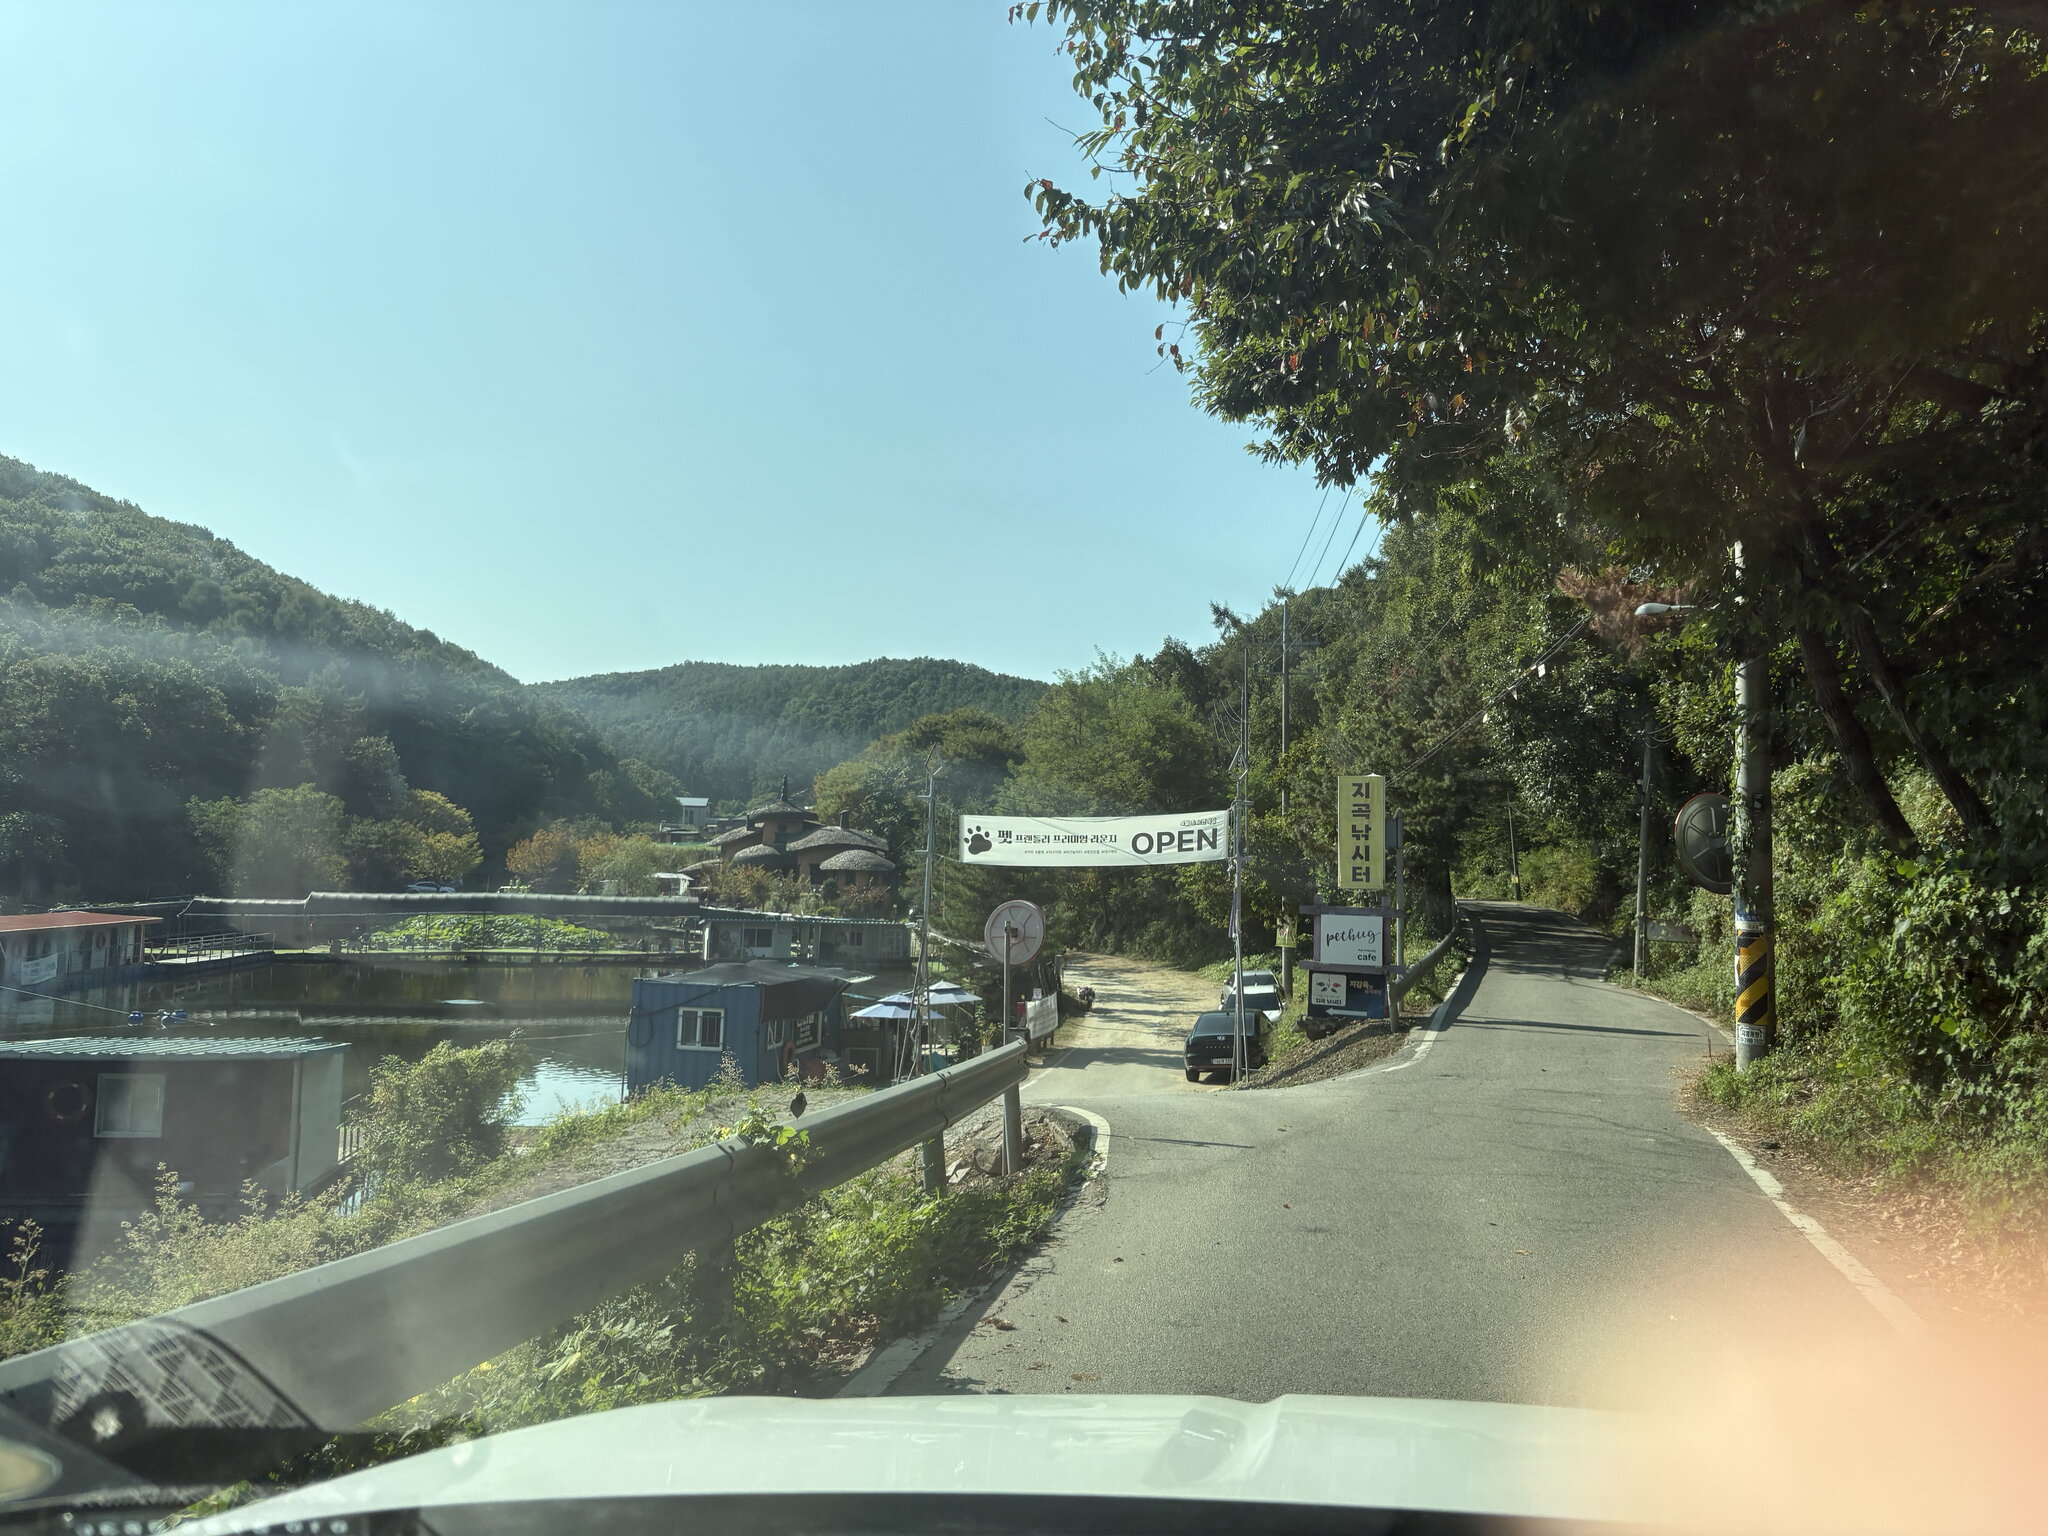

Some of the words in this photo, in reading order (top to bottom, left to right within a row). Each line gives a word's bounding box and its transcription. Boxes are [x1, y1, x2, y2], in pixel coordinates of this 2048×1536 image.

[998, 830, 1012, 844] 펫
[1053, 834, 1088, 844] 프리미엄
[1090, 834, 1117, 844] 라운지
[1131, 827, 1218, 855] OPEN
[1351, 782, 1372, 883] 지곡낚시터
[1326, 928, 1381, 947] pethug
[1357, 953, 1377, 962] cafe
